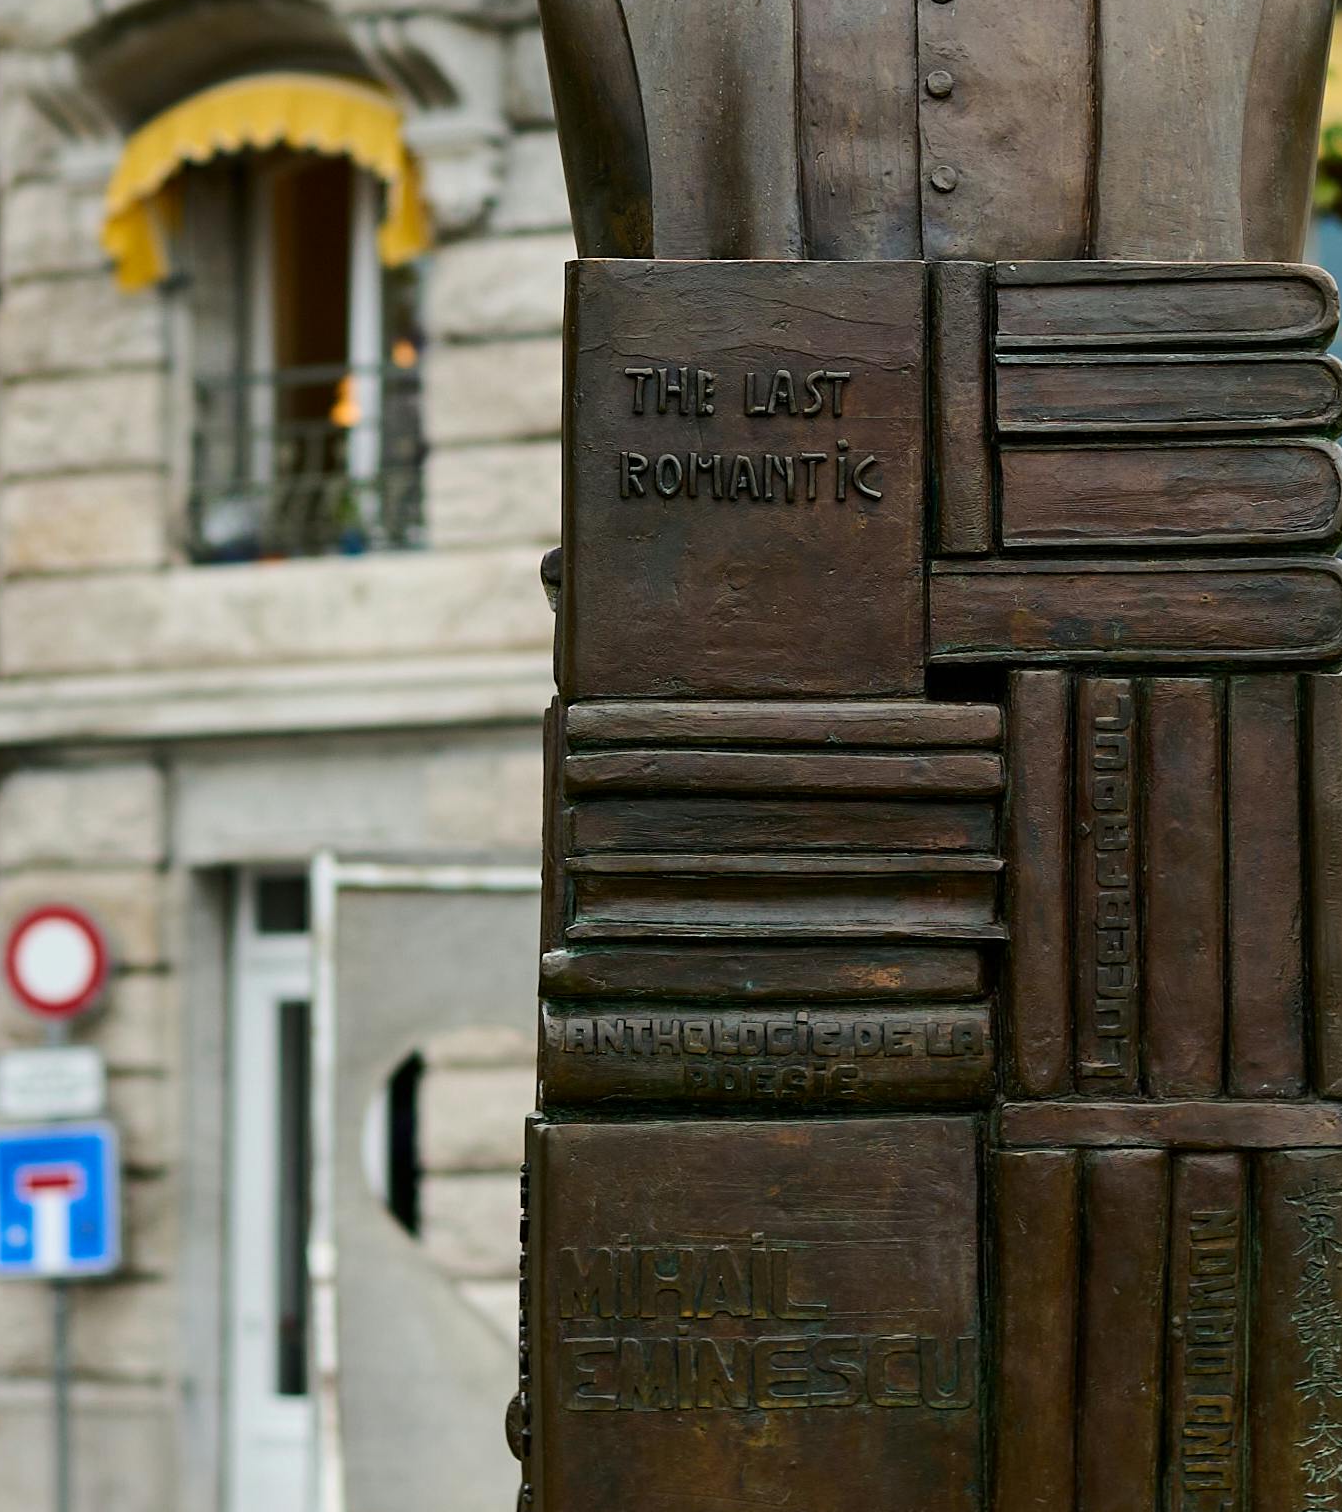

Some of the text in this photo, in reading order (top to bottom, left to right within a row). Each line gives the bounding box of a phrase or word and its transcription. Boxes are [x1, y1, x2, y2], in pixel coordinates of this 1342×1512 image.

[624, 366, 852, 417] THE LAST
[853, 1021, 912, 1058] DE
[924, 1019, 986, 1058] LA
[1182, 1393, 1235, 1492] UND
